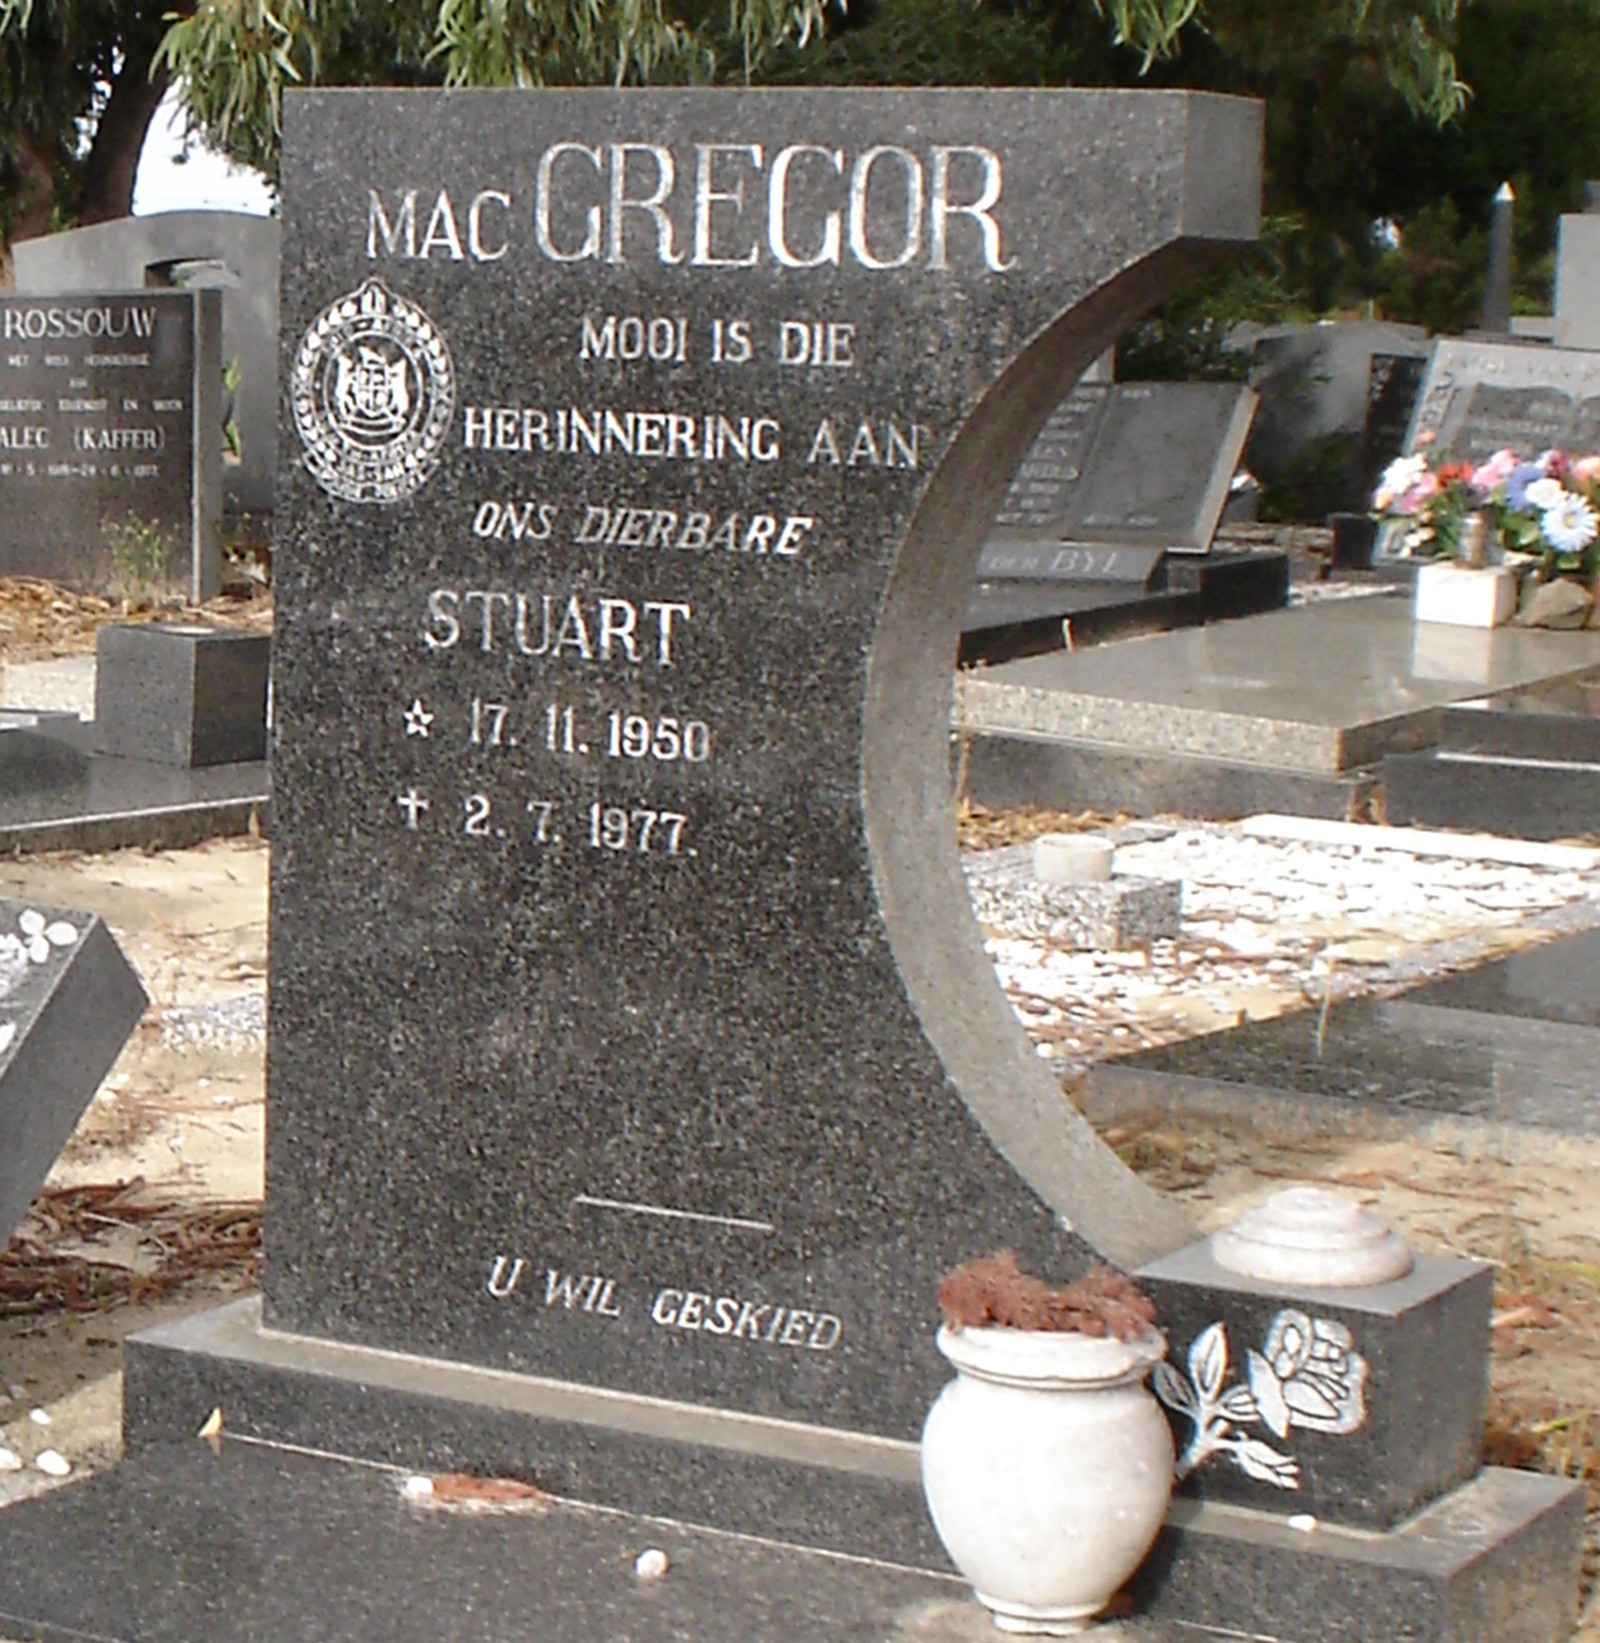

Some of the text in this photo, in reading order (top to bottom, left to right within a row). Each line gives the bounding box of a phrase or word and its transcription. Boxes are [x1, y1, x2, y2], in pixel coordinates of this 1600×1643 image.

[366, 141, 1018, 272] MAC GREGOR
[3, 306, 157, 340] ROSSOUW
[579, 315, 856, 367] MOOI IS DIE
[0, 424, 165, 452] ALEC (KAFFER)
[463, 406, 921, 470] HERINNERING AAN
[472, 501, 814, 555] ONS DIERBARE
[424, 588, 691, 665] STUART
[470, 696, 710, 763] 17. 11. 1950
[463, 794, 506, 838] 2.
[486, 1255, 844, 1351] U WIL GESKIED
